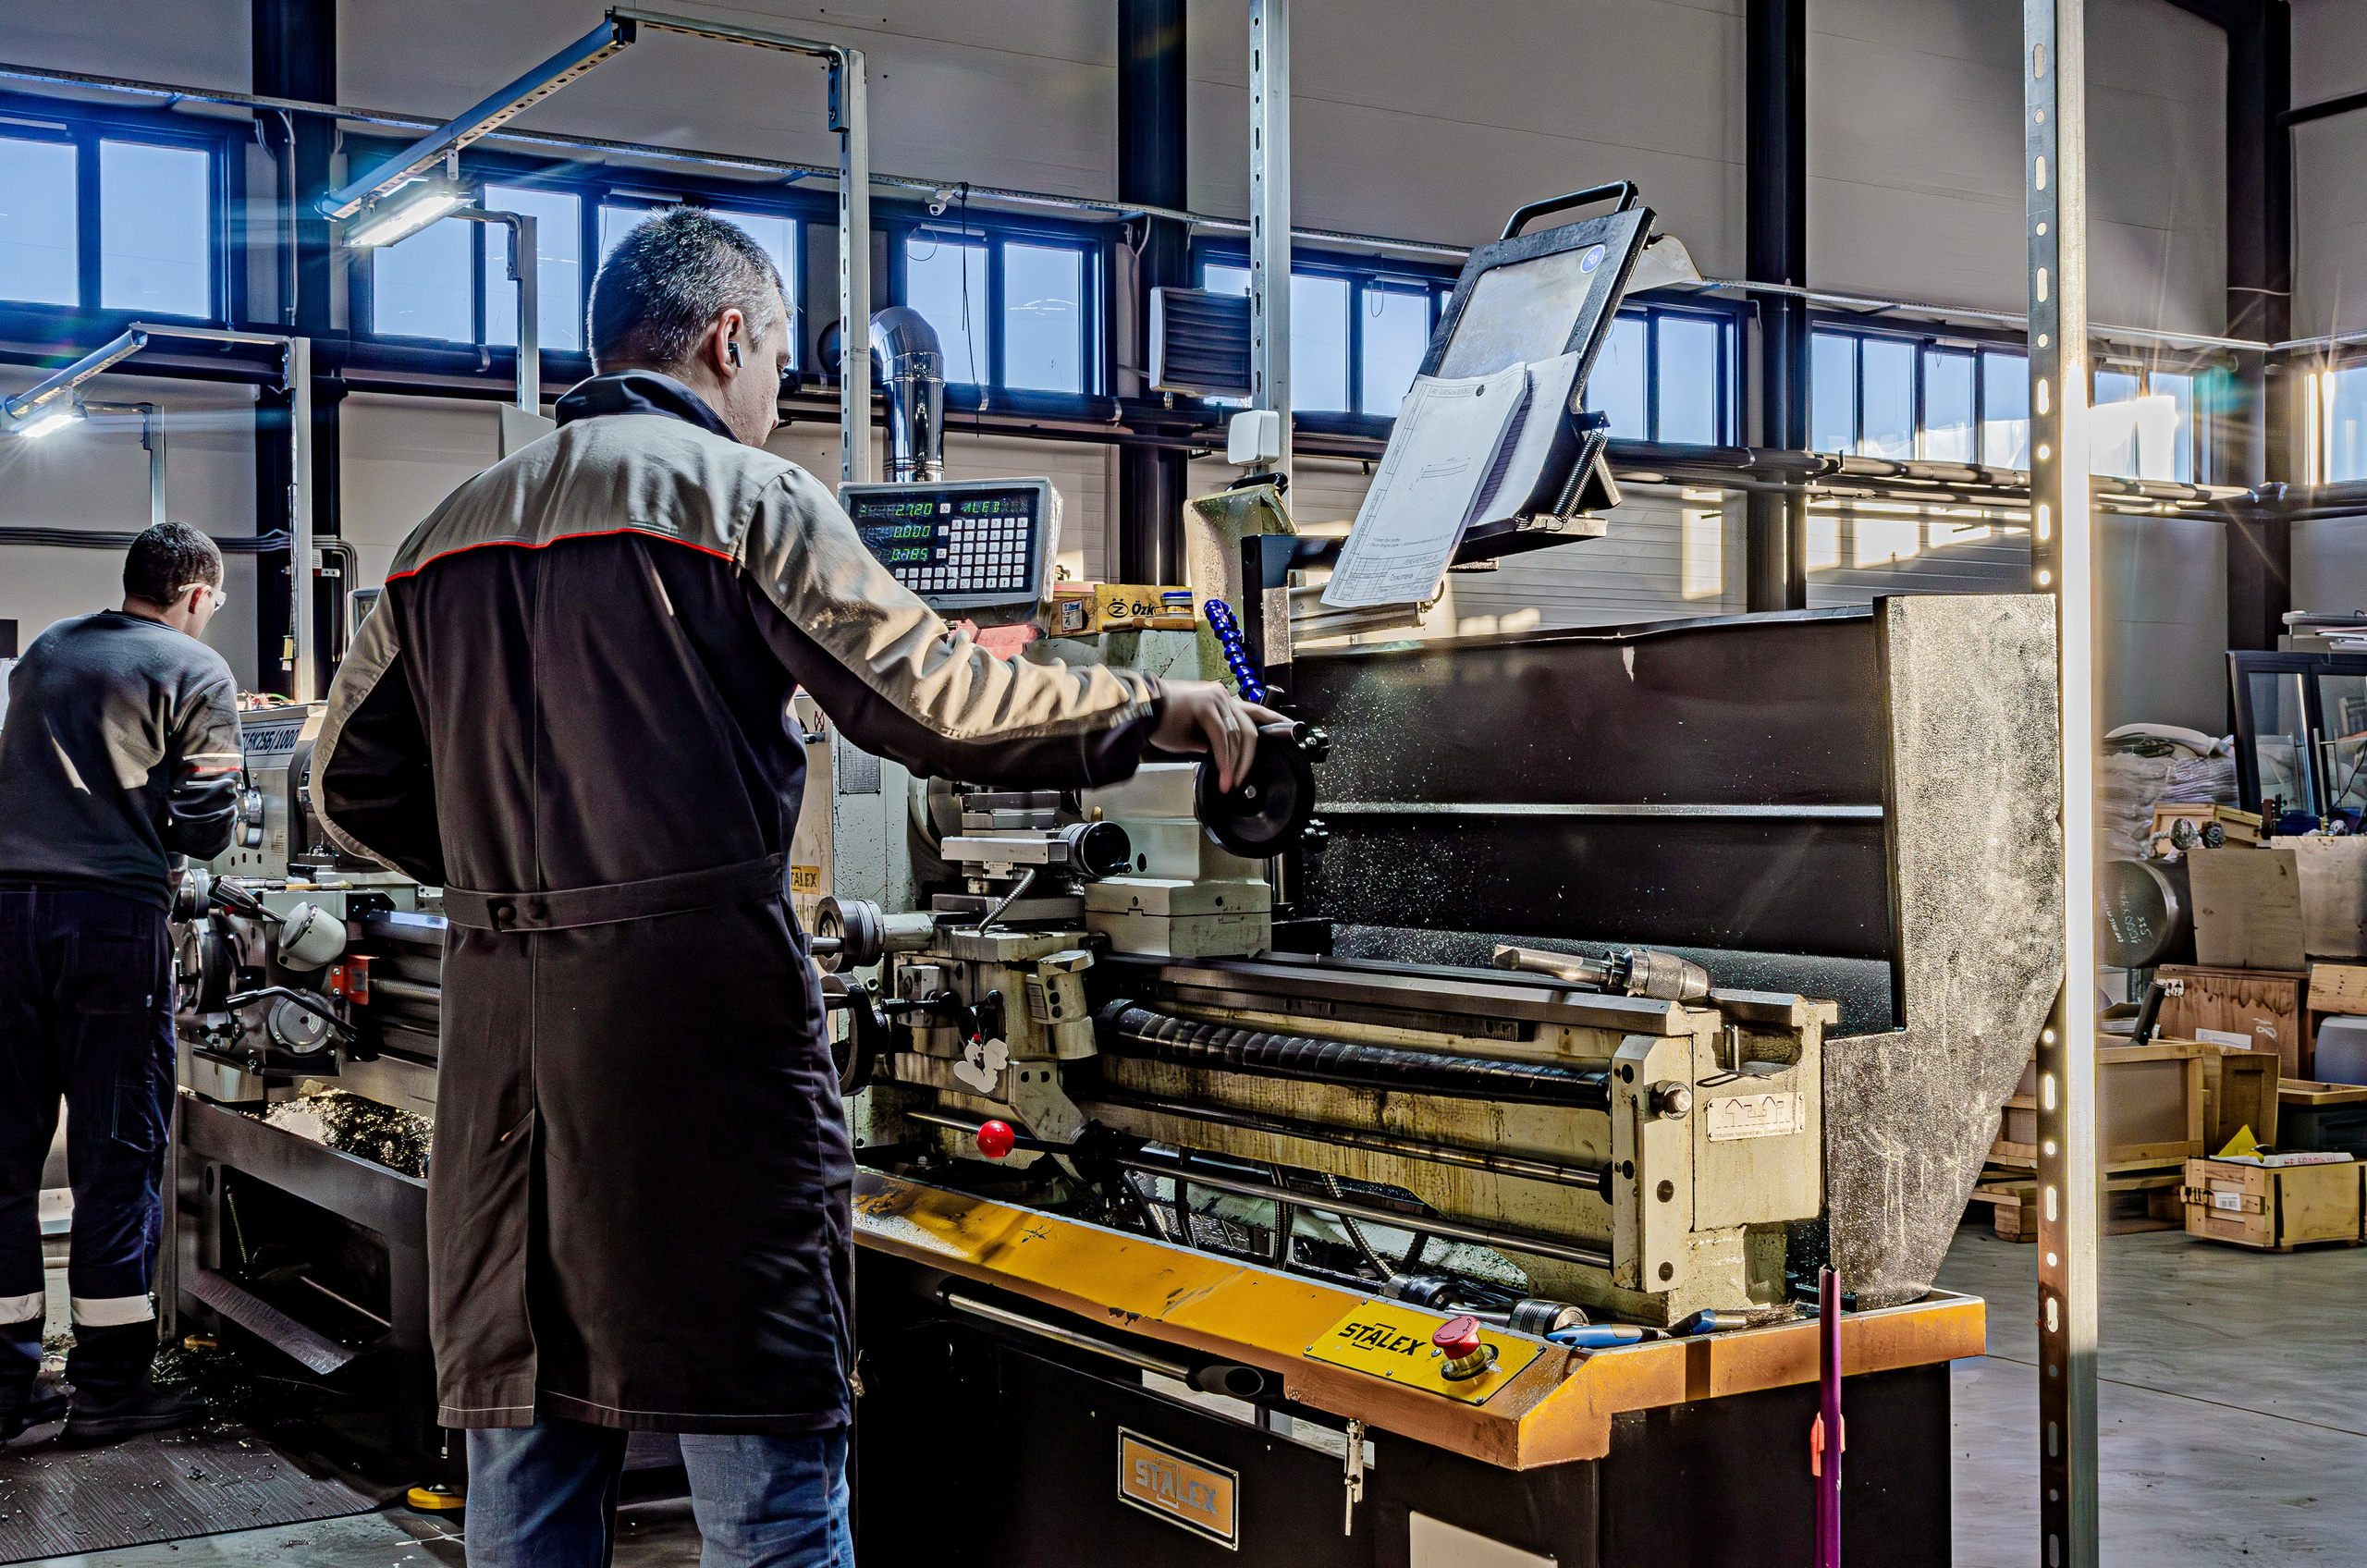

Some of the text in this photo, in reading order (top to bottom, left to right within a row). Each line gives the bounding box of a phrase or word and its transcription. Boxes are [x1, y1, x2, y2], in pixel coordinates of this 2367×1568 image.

[1131, 600, 1157, 616] Özk
[791, 872, 817, 888] TALEX
[1337, 1323, 1428, 1356] STALEX
[1135, 1458, 1218, 1515] STALEX
